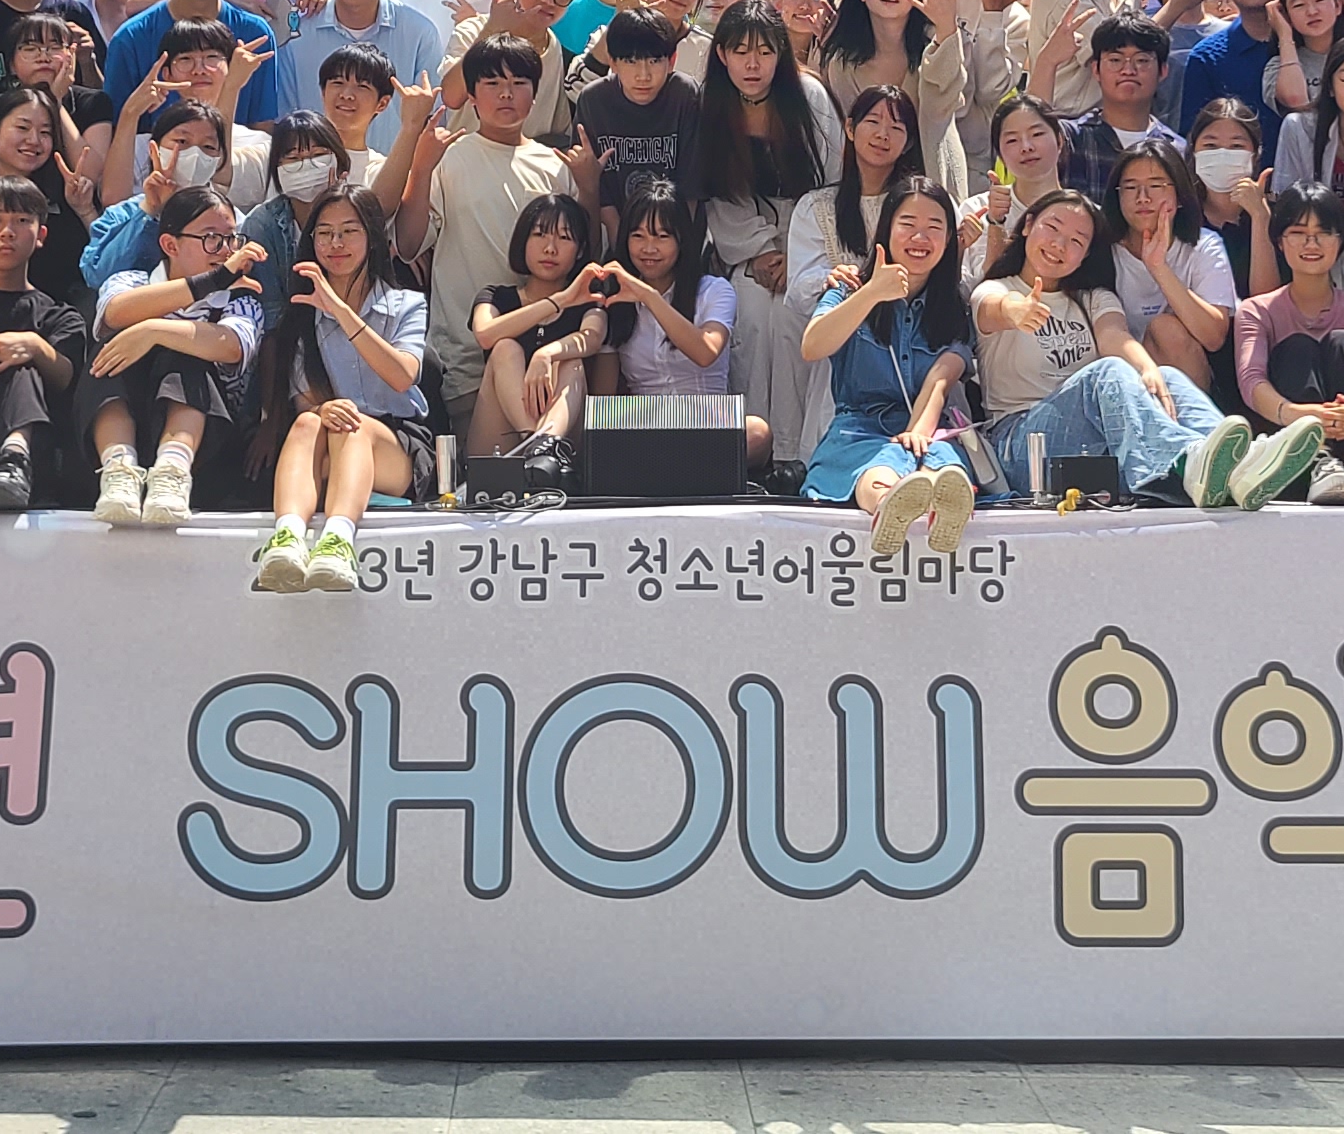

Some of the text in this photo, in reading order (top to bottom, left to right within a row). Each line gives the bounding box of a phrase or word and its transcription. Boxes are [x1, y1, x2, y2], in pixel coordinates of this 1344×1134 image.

[597, 133, 678, 172] MICHIGAN
[1034, 315, 1066, 337] ow
[459, 537, 605, 602] 강남구
[177, 670, 986, 901] SHOW
